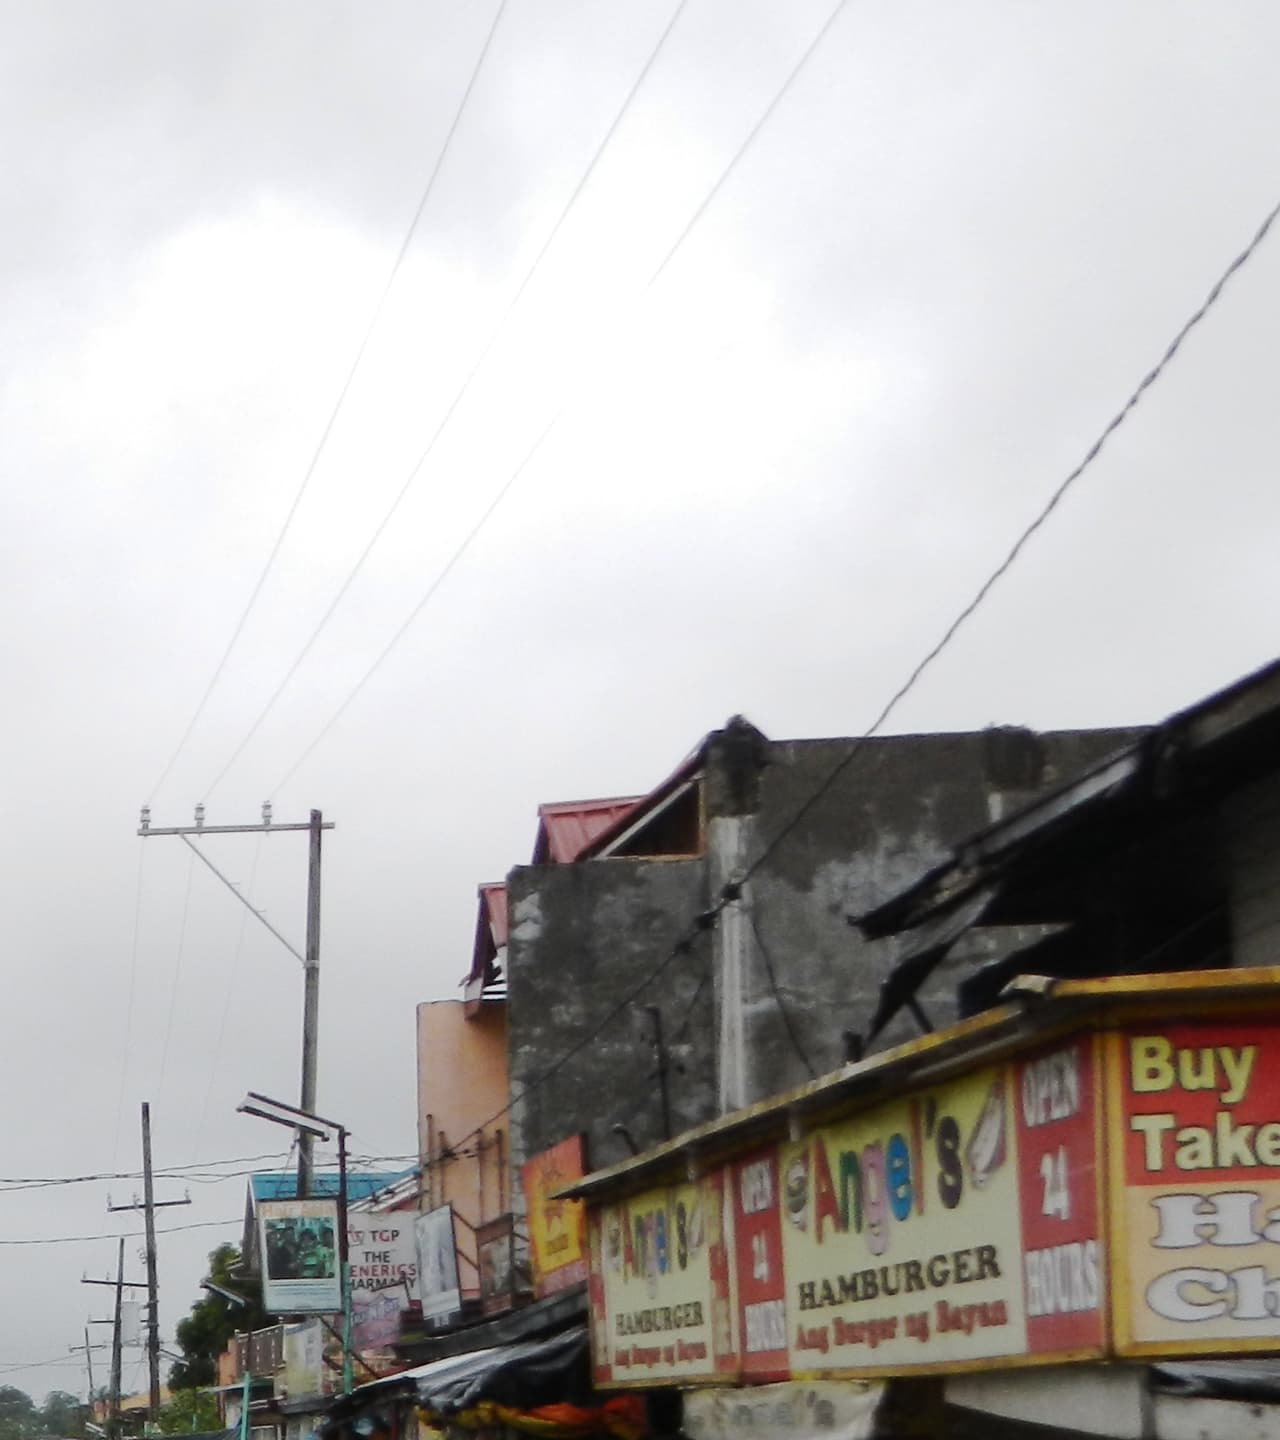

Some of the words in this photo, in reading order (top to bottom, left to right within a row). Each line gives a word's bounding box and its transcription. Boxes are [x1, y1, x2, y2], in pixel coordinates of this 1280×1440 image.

[1023, 1046, 1080, 1128] OPEN
[1130, 1035, 1257, 1104] Buy
[1130, 1111, 1280, 1172] Take
[813, 1097, 963, 1256] Angel's
[1042, 1144, 1069, 1221] 24
[370, 1229, 400, 1243] TGP
[1150, 1190, 1280, 1250] H
[349, 1263, 417, 1277] ENERICS
[351, 1277, 417, 1291] HARMACY
[362, 1250, 391, 1263] THE
[797, 1244, 1001, 1311] HAMBURGER
[1025, 1239, 1101, 1318] HOURS
[615, 1301, 705, 1336] HAMBURGER
[795, 1322, 829, 1354] Ang
[831, 1314, 899, 1349] Burger
[936, 1299, 1008, 1336] Bayan
